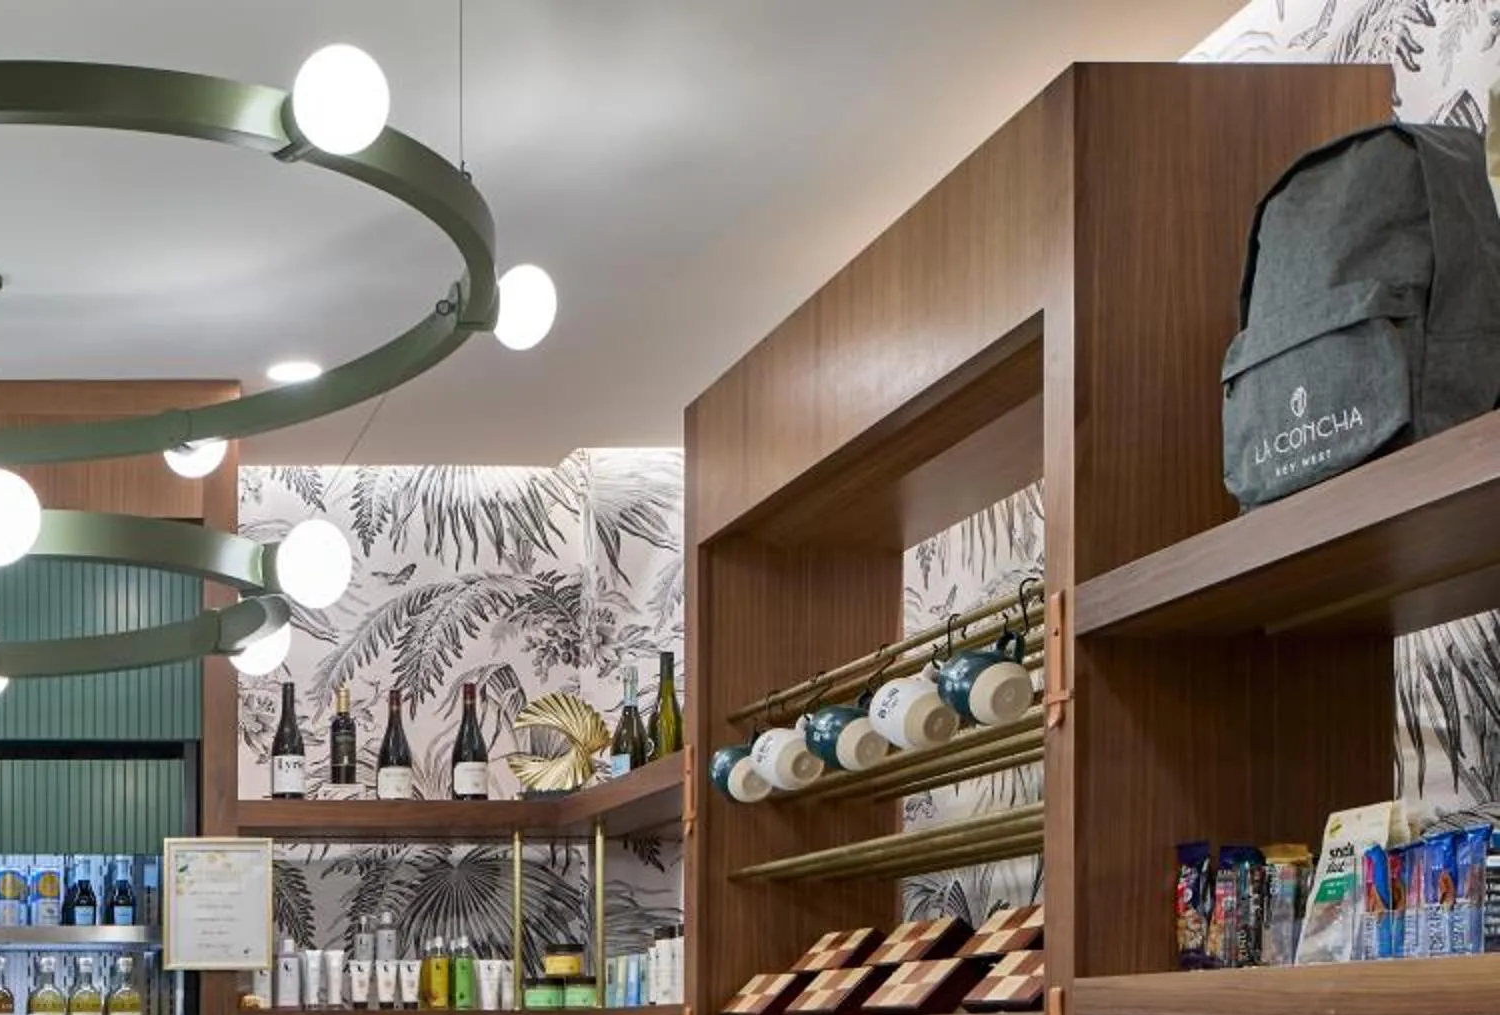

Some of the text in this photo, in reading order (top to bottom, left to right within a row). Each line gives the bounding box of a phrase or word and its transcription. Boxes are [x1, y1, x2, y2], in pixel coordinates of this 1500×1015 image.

[1254, 405, 1363, 465] LA CONCHA
[1301, 448, 1331, 467] WEST
